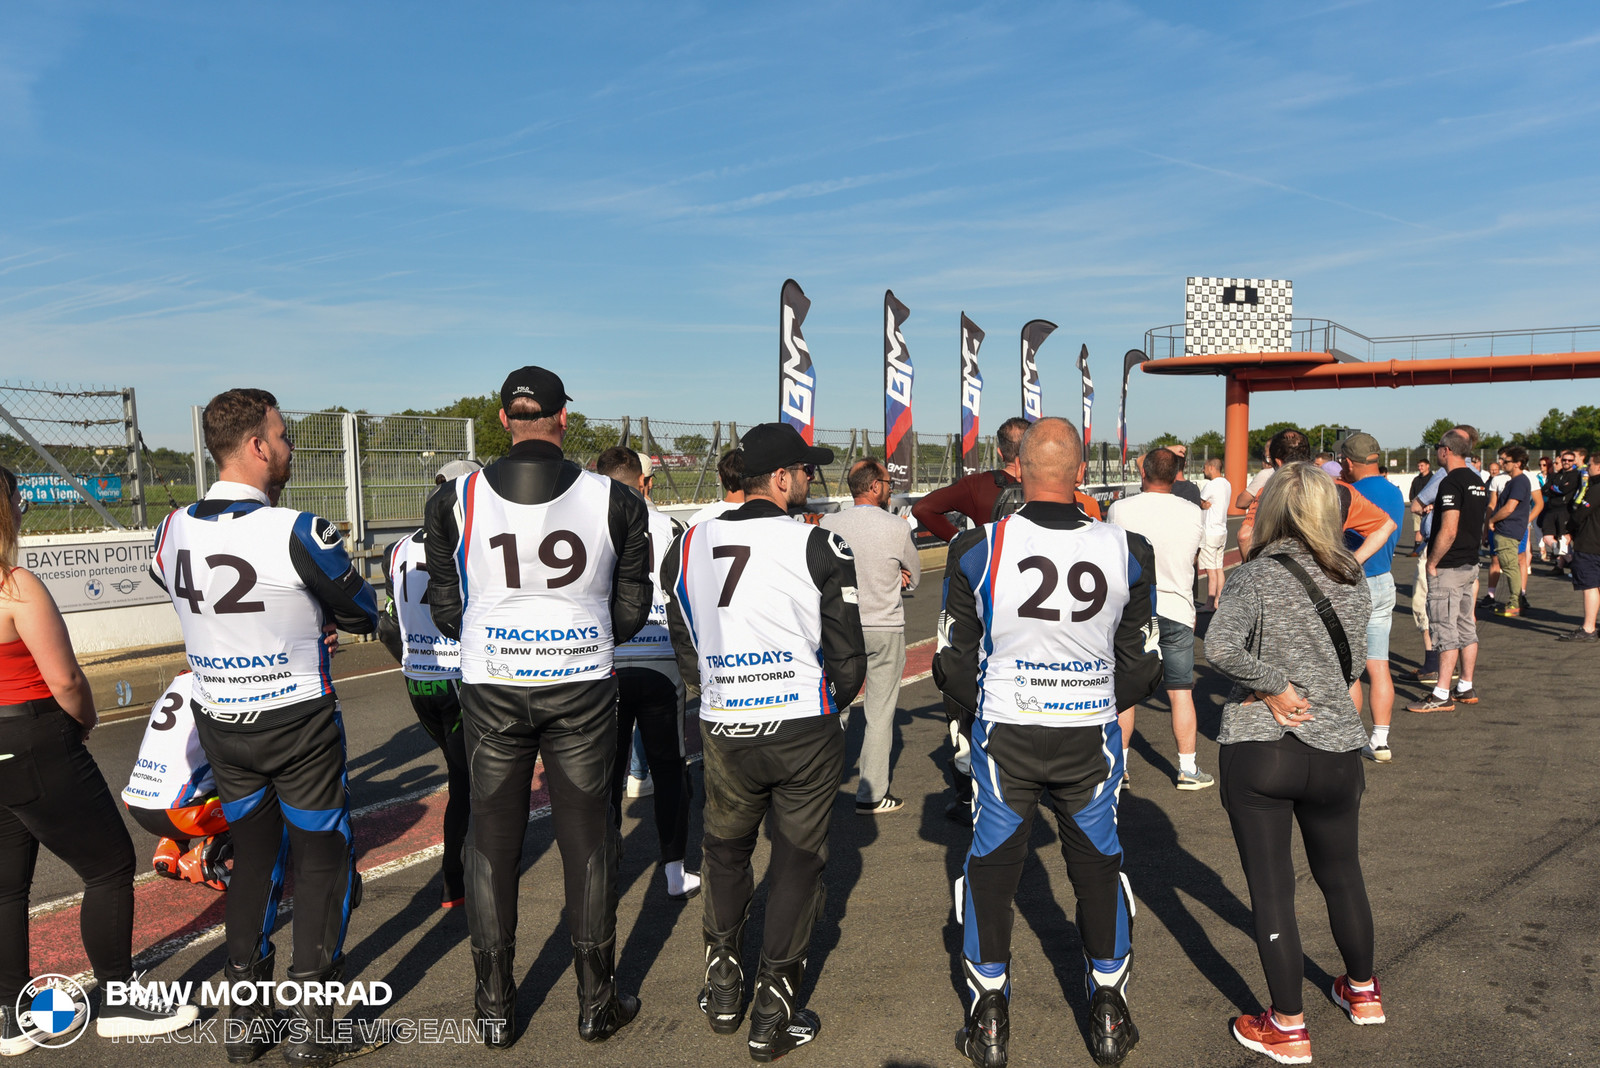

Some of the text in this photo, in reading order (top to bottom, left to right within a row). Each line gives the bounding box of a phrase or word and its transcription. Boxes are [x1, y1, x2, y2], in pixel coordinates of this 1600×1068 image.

[887, 462, 908, 475] BMC
[20, 490, 33, 500] de
[37, 488, 47, 499] la
[26, 545, 156, 568] BAYERN POITIE
[489, 530, 587, 589] 19
[89, 564, 137, 578] partenaire
[712, 545, 751, 608] 7
[175, 549, 266, 614] 42
[1016, 555, 1108, 623] 29
[406, 633, 457, 646] ACKDAYS
[485, 626, 599, 642] TRACKDAYS
[420, 649, 459, 657] MOTORRAD
[500, 645, 599, 656] BMW MOTORRAD
[188, 652, 289, 670] TRACKDAYS
[706, 651, 793, 669] TRACKDAYS
[1015, 659, 1108, 672] TRACKDAYS
[204, 671, 292, 684] BMW MOTORRAD
[515, 663, 599, 677] MICHELIN
[715, 670, 795, 685] BMW MOTORRAD
[1030, 676, 1109, 687] BMW MOTORRAD
[116, 680, 132, 706] 9
[217, 683, 298, 703] MICHELIN
[726, 692, 799, 708] MICHELIN
[1044, 697, 1110, 712] MICHELIN
[136, 758, 167, 774] KDAYS
[133, 772, 162, 784] MOTORRAD
